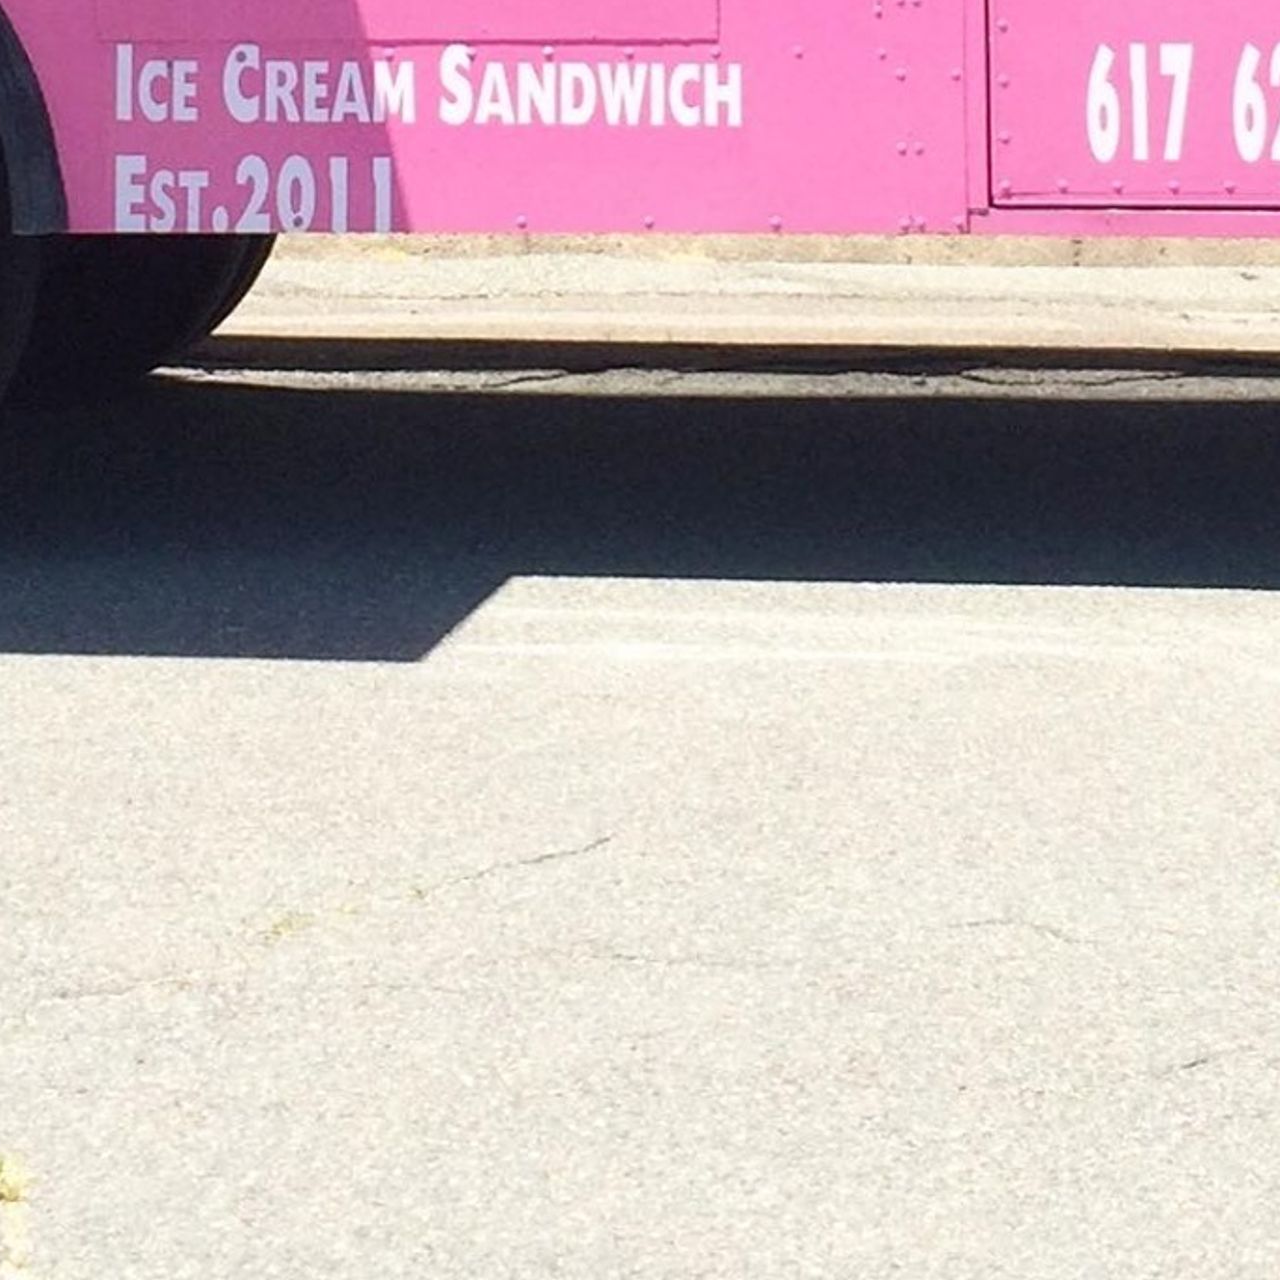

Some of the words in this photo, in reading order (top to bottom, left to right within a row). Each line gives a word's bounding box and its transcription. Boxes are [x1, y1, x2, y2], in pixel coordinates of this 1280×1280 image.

[115, 43, 199, 123] ICE
[223, 43, 415, 125] CREAM
[438, 44, 743, 128] SANDWICH
[1086, 42, 1194, 163] 617
